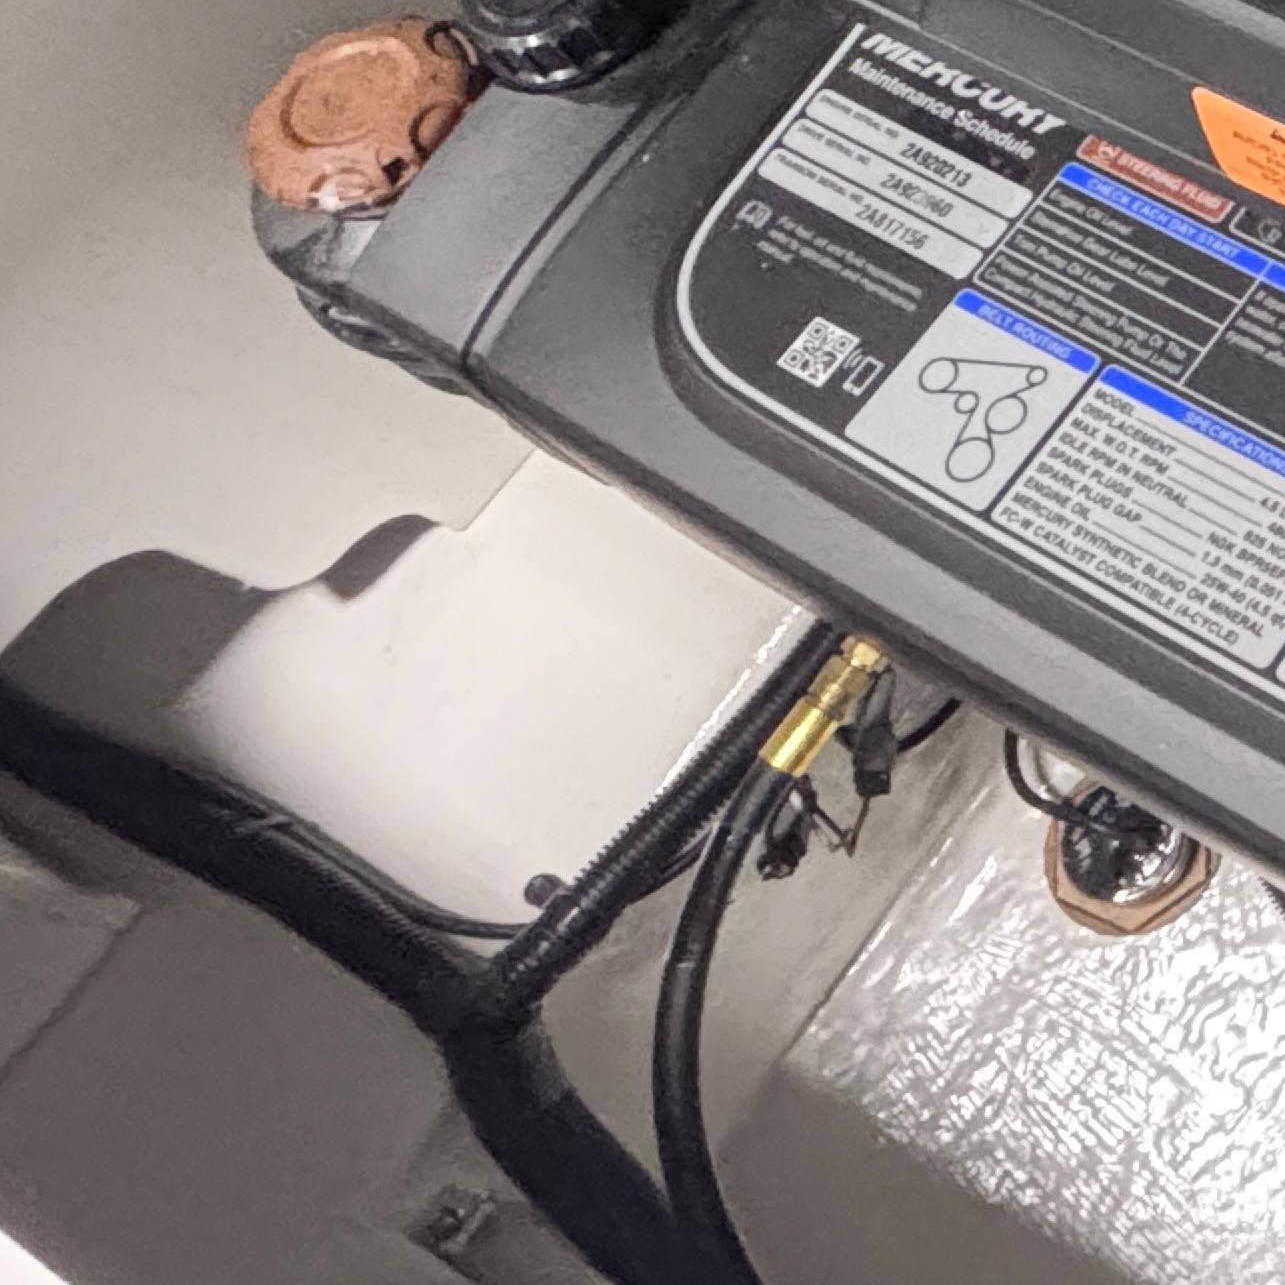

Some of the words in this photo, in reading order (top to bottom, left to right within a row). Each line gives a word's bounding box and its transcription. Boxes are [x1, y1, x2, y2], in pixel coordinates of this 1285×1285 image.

[844, 56, 959, 121] Maintenance
[948, 107, 1041, 162] Schedule
[859, 29, 1067, 140] MERCURY
[1046, 187, 1090, 216] Engine
[1083, 204, 1105, 222] Oil
[1099, 213, 1134, 237] Level
[1084, 176, 1133, 207] CHECK
[1128, 198, 1171, 225] EACH
[1166, 216, 1199, 239] DAY
[1194, 230, 1240, 259] START
[1032, 244, 1070, 270] Pump
[1064, 260, 1087, 278] Oil
[1080, 268, 1117, 294] Level
[1079, 235, 1113, 259] Gear
[1107, 248, 1141, 273] Lube
[1134, 262, 1171, 287] Level
[975, 302, 1015, 329] BELT
[1009, 319, 1074, 360] ROUTING
[1112, 315, 1152, 344] Pump
[1162, 340, 1190, 361] The
[1147, 351, 1184, 377] Level
[1091, 387, 1137, 417] MODEL
[1045, 445, 1091, 476] SPARK
[1086, 467, 1134, 500] PLUGS
[1055, 430, 1089, 455] IDLE
[1085, 446, 1118, 470] RPM
[1113, 461, 1133, 478] IN
[1128, 469, 1191, 510] NEUTRAL
[1079, 401, 1177, 459] DISPLACEMENT
[1257, 493, 1281, 513] 4.5
[1137, 453, 1170, 477] RPM
[1021, 475, 1073, 509] ENGINE
[1033, 460, 1080, 492] SPARK
[1075, 482, 1115, 511] PLUG
[1111, 502, 1144, 526] GAP
[1218, 562, 1245, 582] mm
[997, 505, 1036, 533] FC-W
[1030, 523, 1096, 566] CATALYST
[1092, 558, 1177, 611] COMPATIBLE
[1172, 601, 1241, 647] (4-CYCLE)
[1009, 490, 1073, 531] MERCURY
[1069, 523, 1144, 570] SYNTHETIC
[1139, 561, 1188, 594] BLEND
[1184, 585, 1210, 606] OR
[1205, 597, 1268, 638] MINERAL
